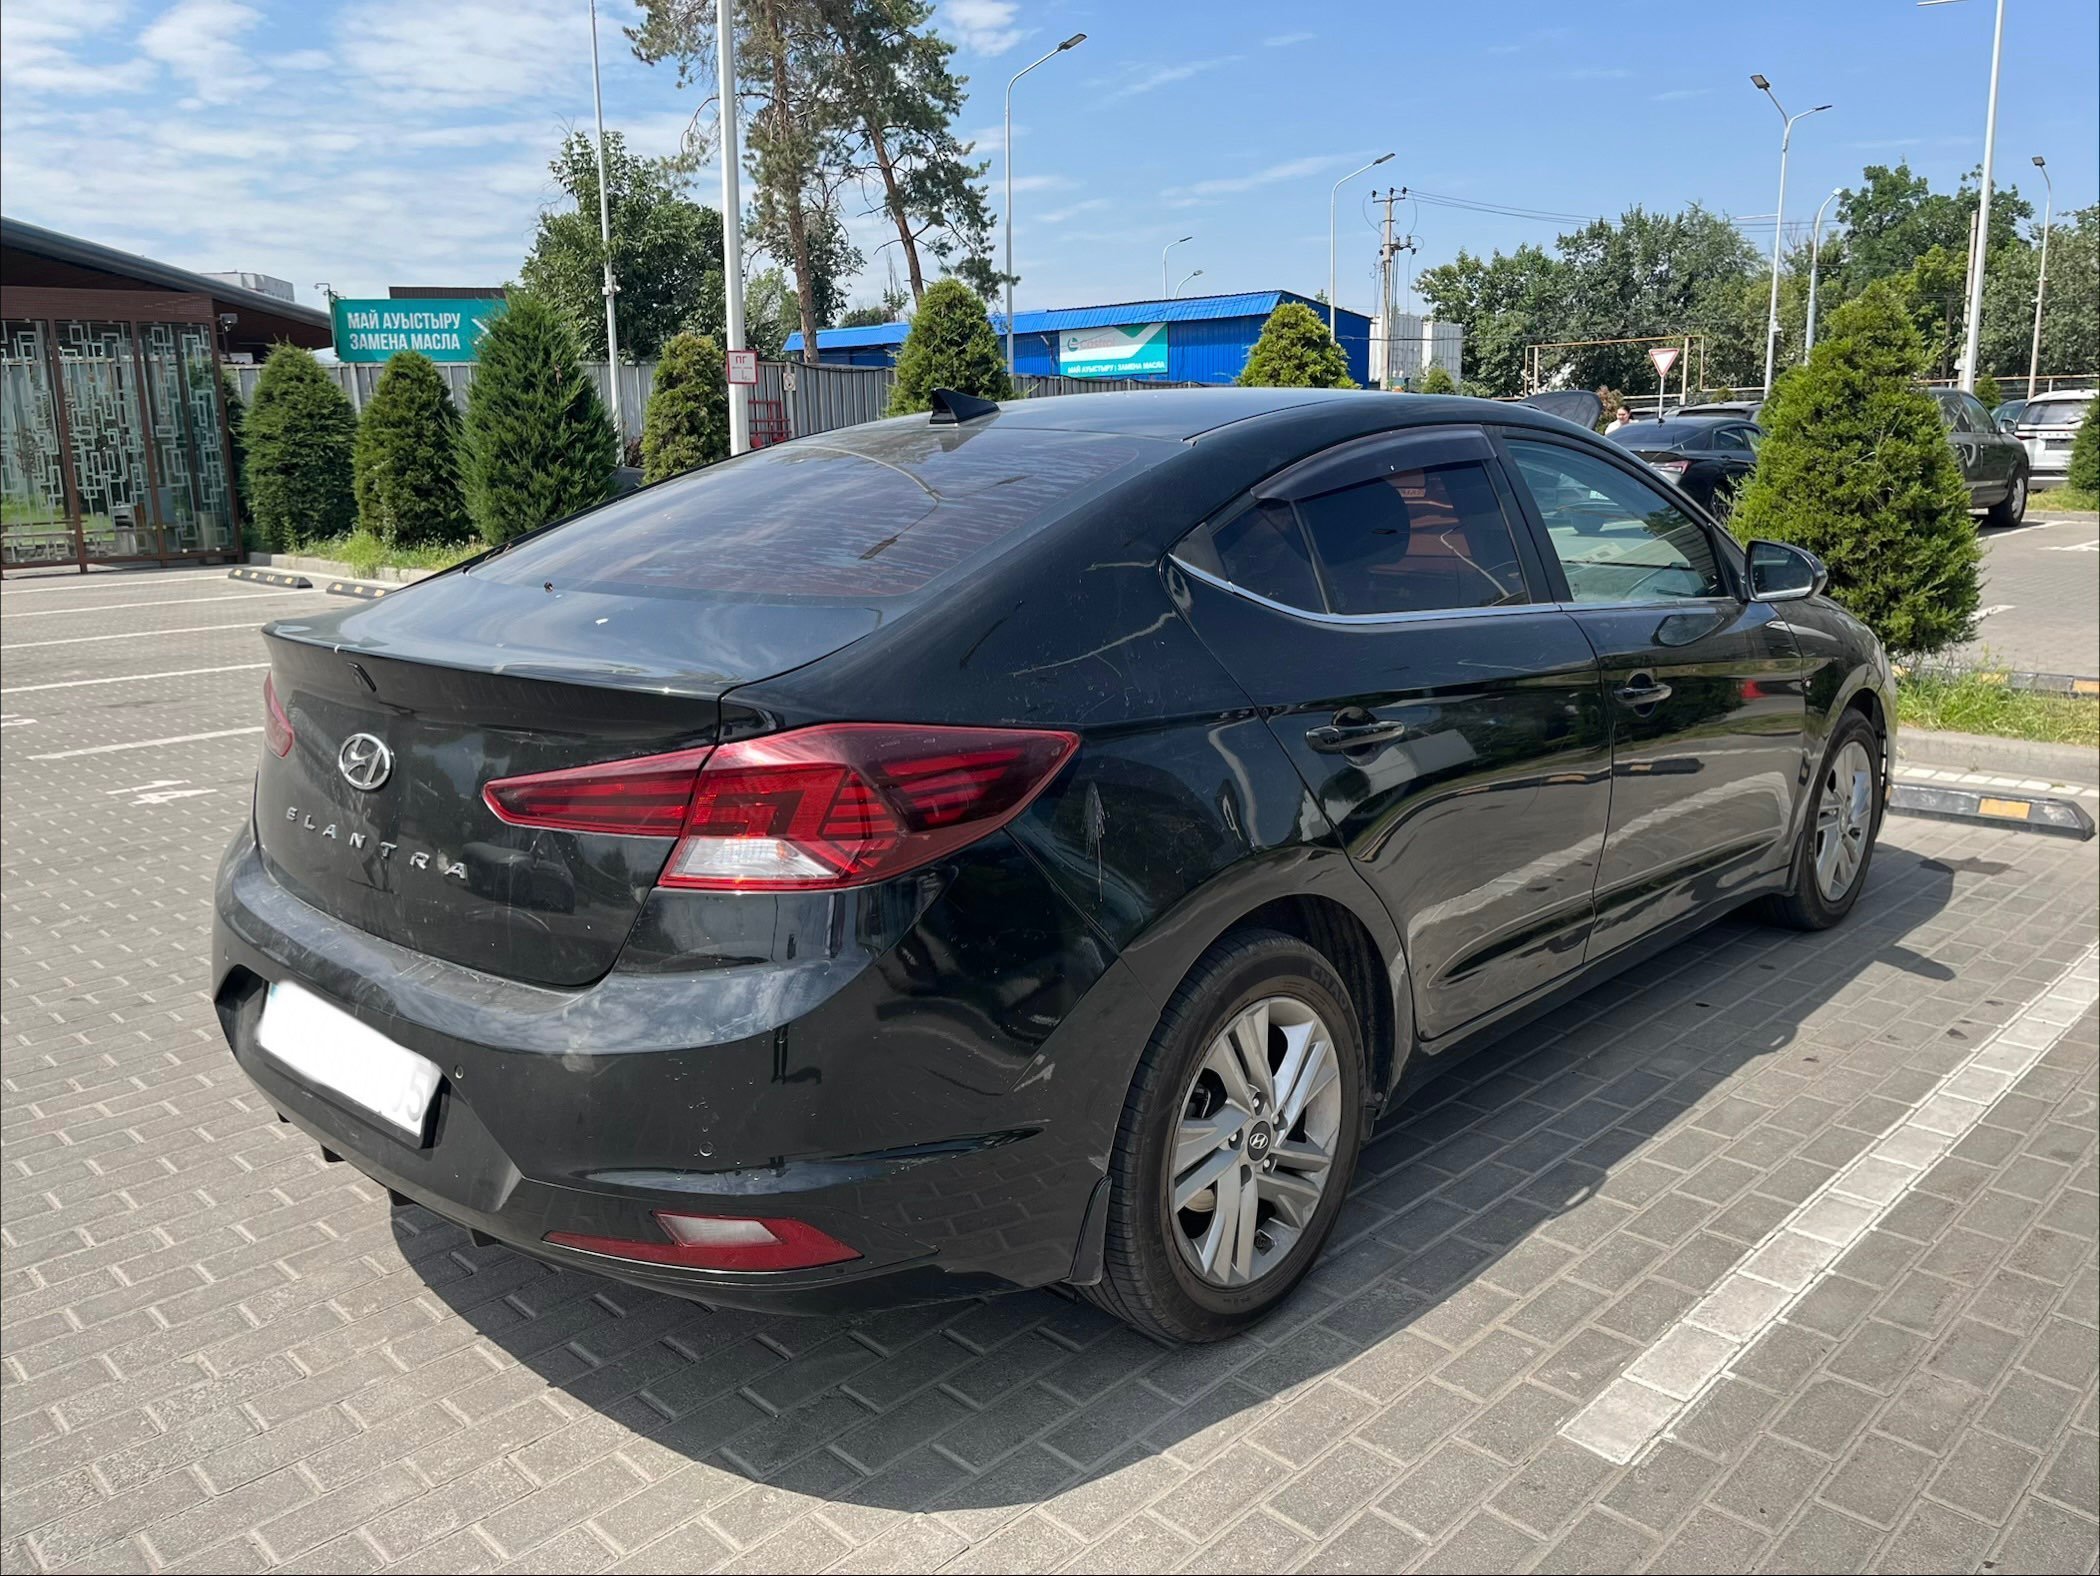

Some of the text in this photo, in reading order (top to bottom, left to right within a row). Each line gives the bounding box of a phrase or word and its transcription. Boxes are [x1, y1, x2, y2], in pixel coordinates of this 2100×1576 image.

[347, 309, 461, 329] МАЙ АУЫСТЫРУ
[350, 333, 461, 350] ЗАМЕНА МАСЛА
[736, 356, 747, 364] ПГ
[1067, 364, 1081, 374] МАЙ
[286, 806, 468, 880] ELANTRA
